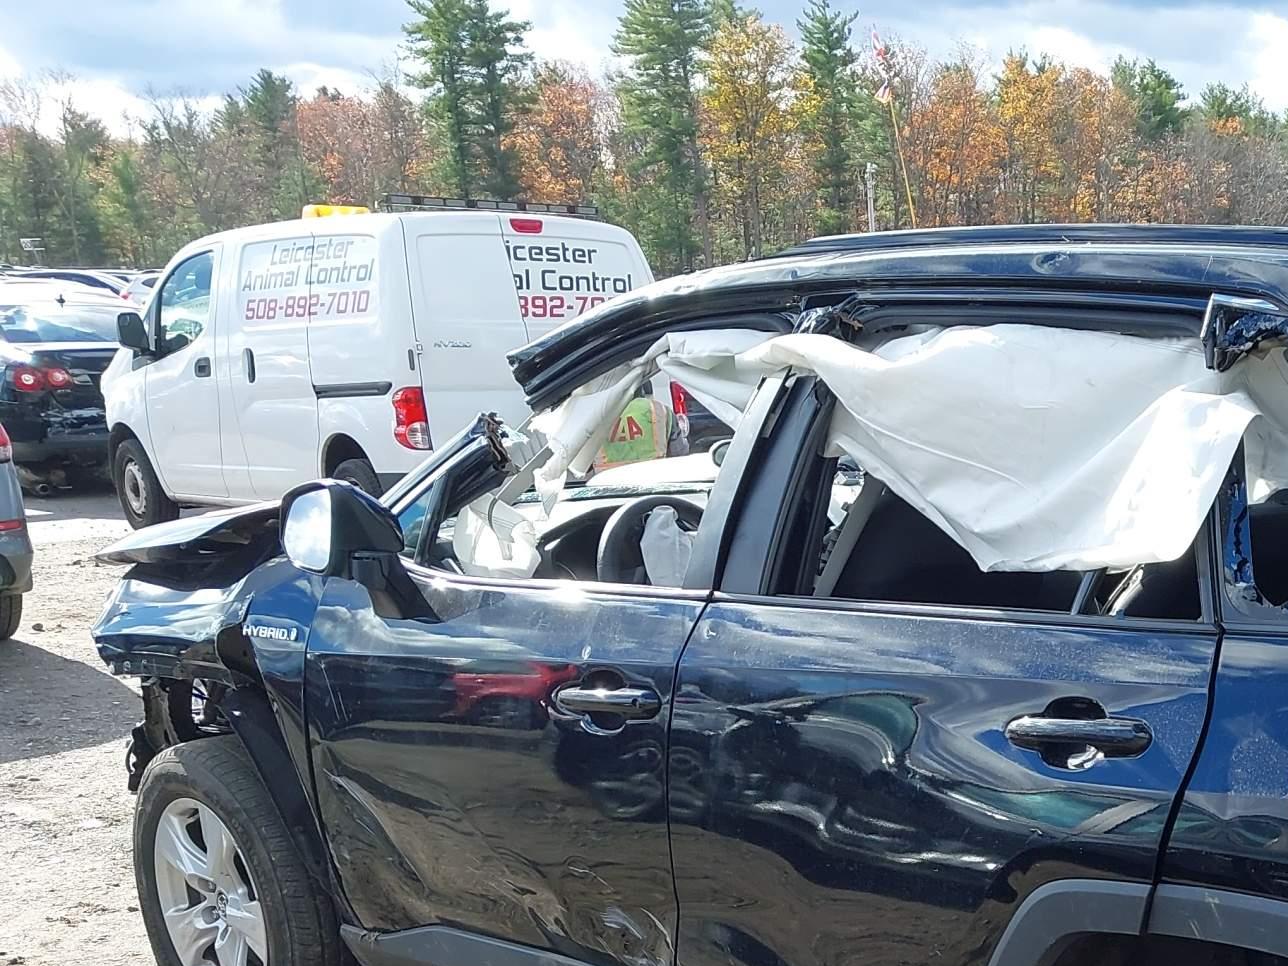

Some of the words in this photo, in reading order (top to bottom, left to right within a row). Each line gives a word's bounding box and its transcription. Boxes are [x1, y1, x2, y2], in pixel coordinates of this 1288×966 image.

[270, 238, 354, 266] Leicester
[242, 265, 301, 292] Animal
[304, 258, 375, 286] Control
[541, 270, 633, 294] Control
[245, 290, 371, 321] 508-892-7010
[519, 295, 613, 318] 892-7
[242, 624, 288, 641] HYBRID
